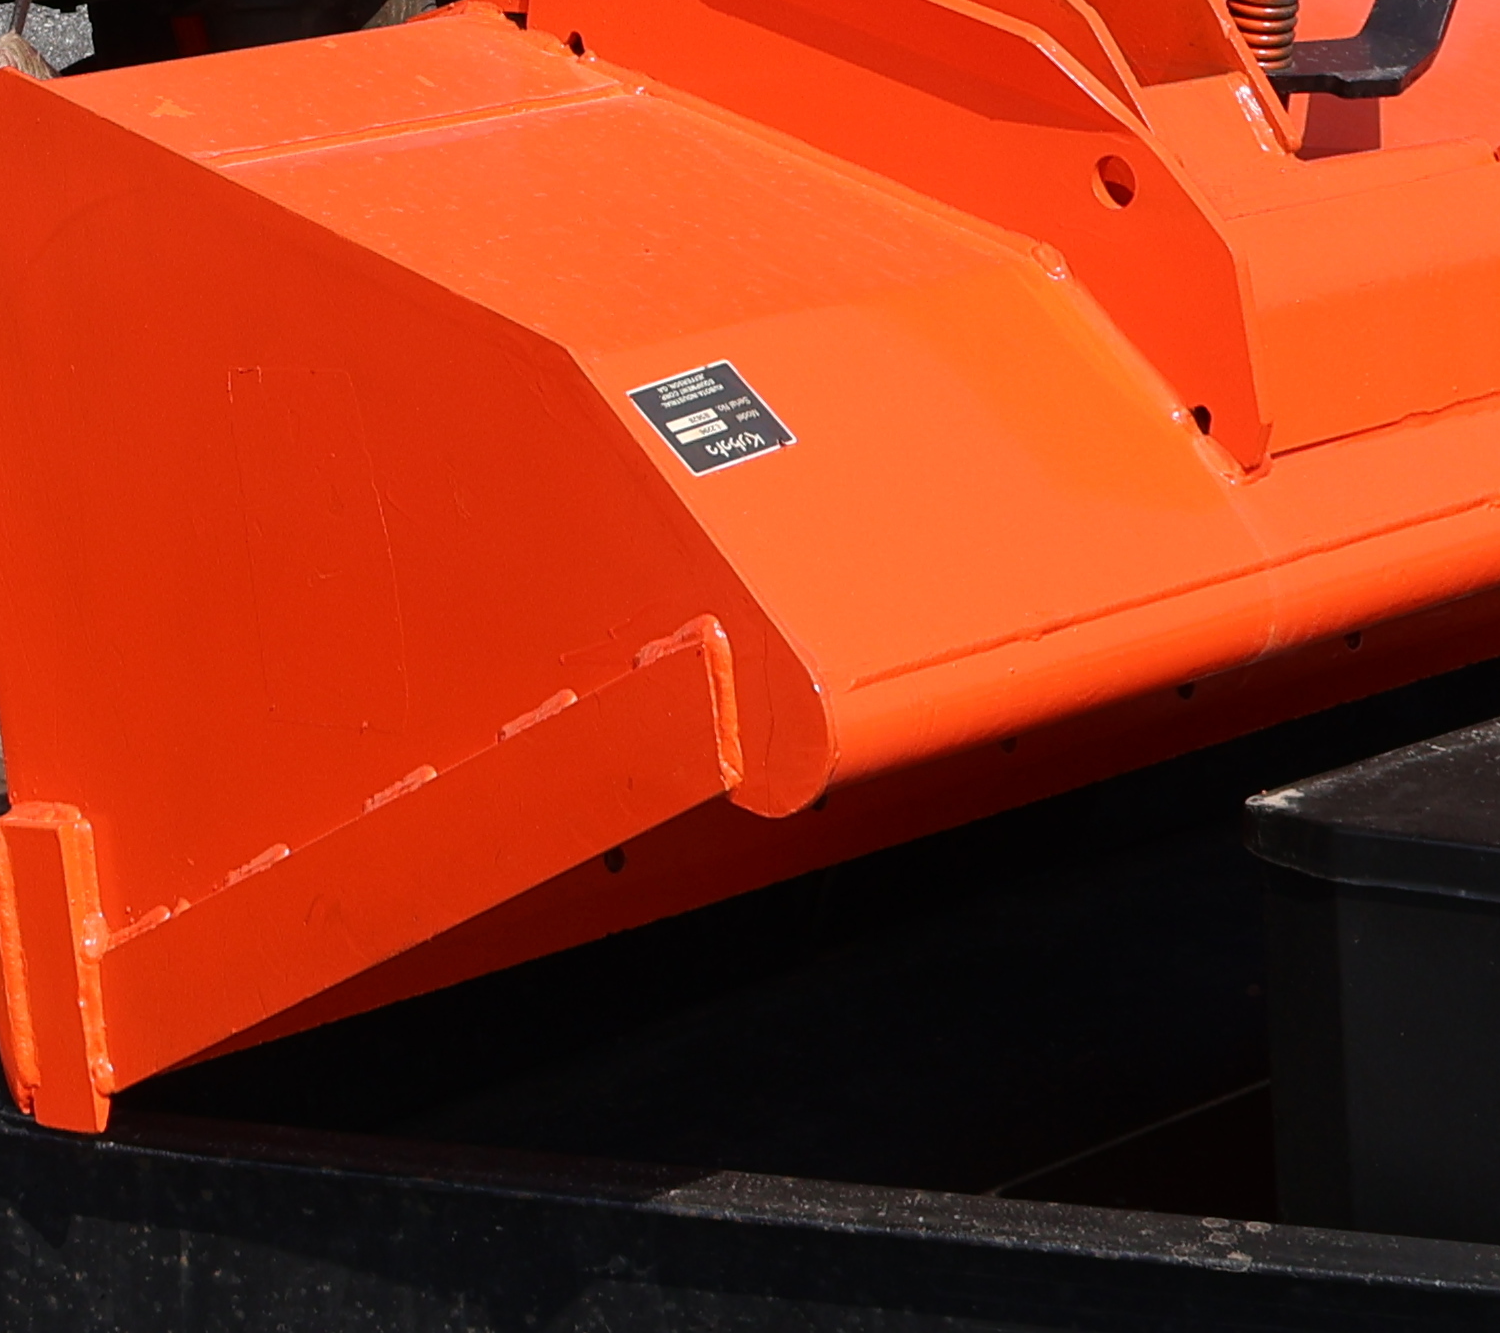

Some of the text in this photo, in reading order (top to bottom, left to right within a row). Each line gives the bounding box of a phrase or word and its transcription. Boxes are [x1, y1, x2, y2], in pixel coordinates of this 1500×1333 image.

[680, 378, 715, 393] EQUIPMENT
[661, 384, 724, 408] KUBOTA INDUSTRIAL
[728, 396, 751, 408] Serial
[705, 432, 765, 457] Kubota
